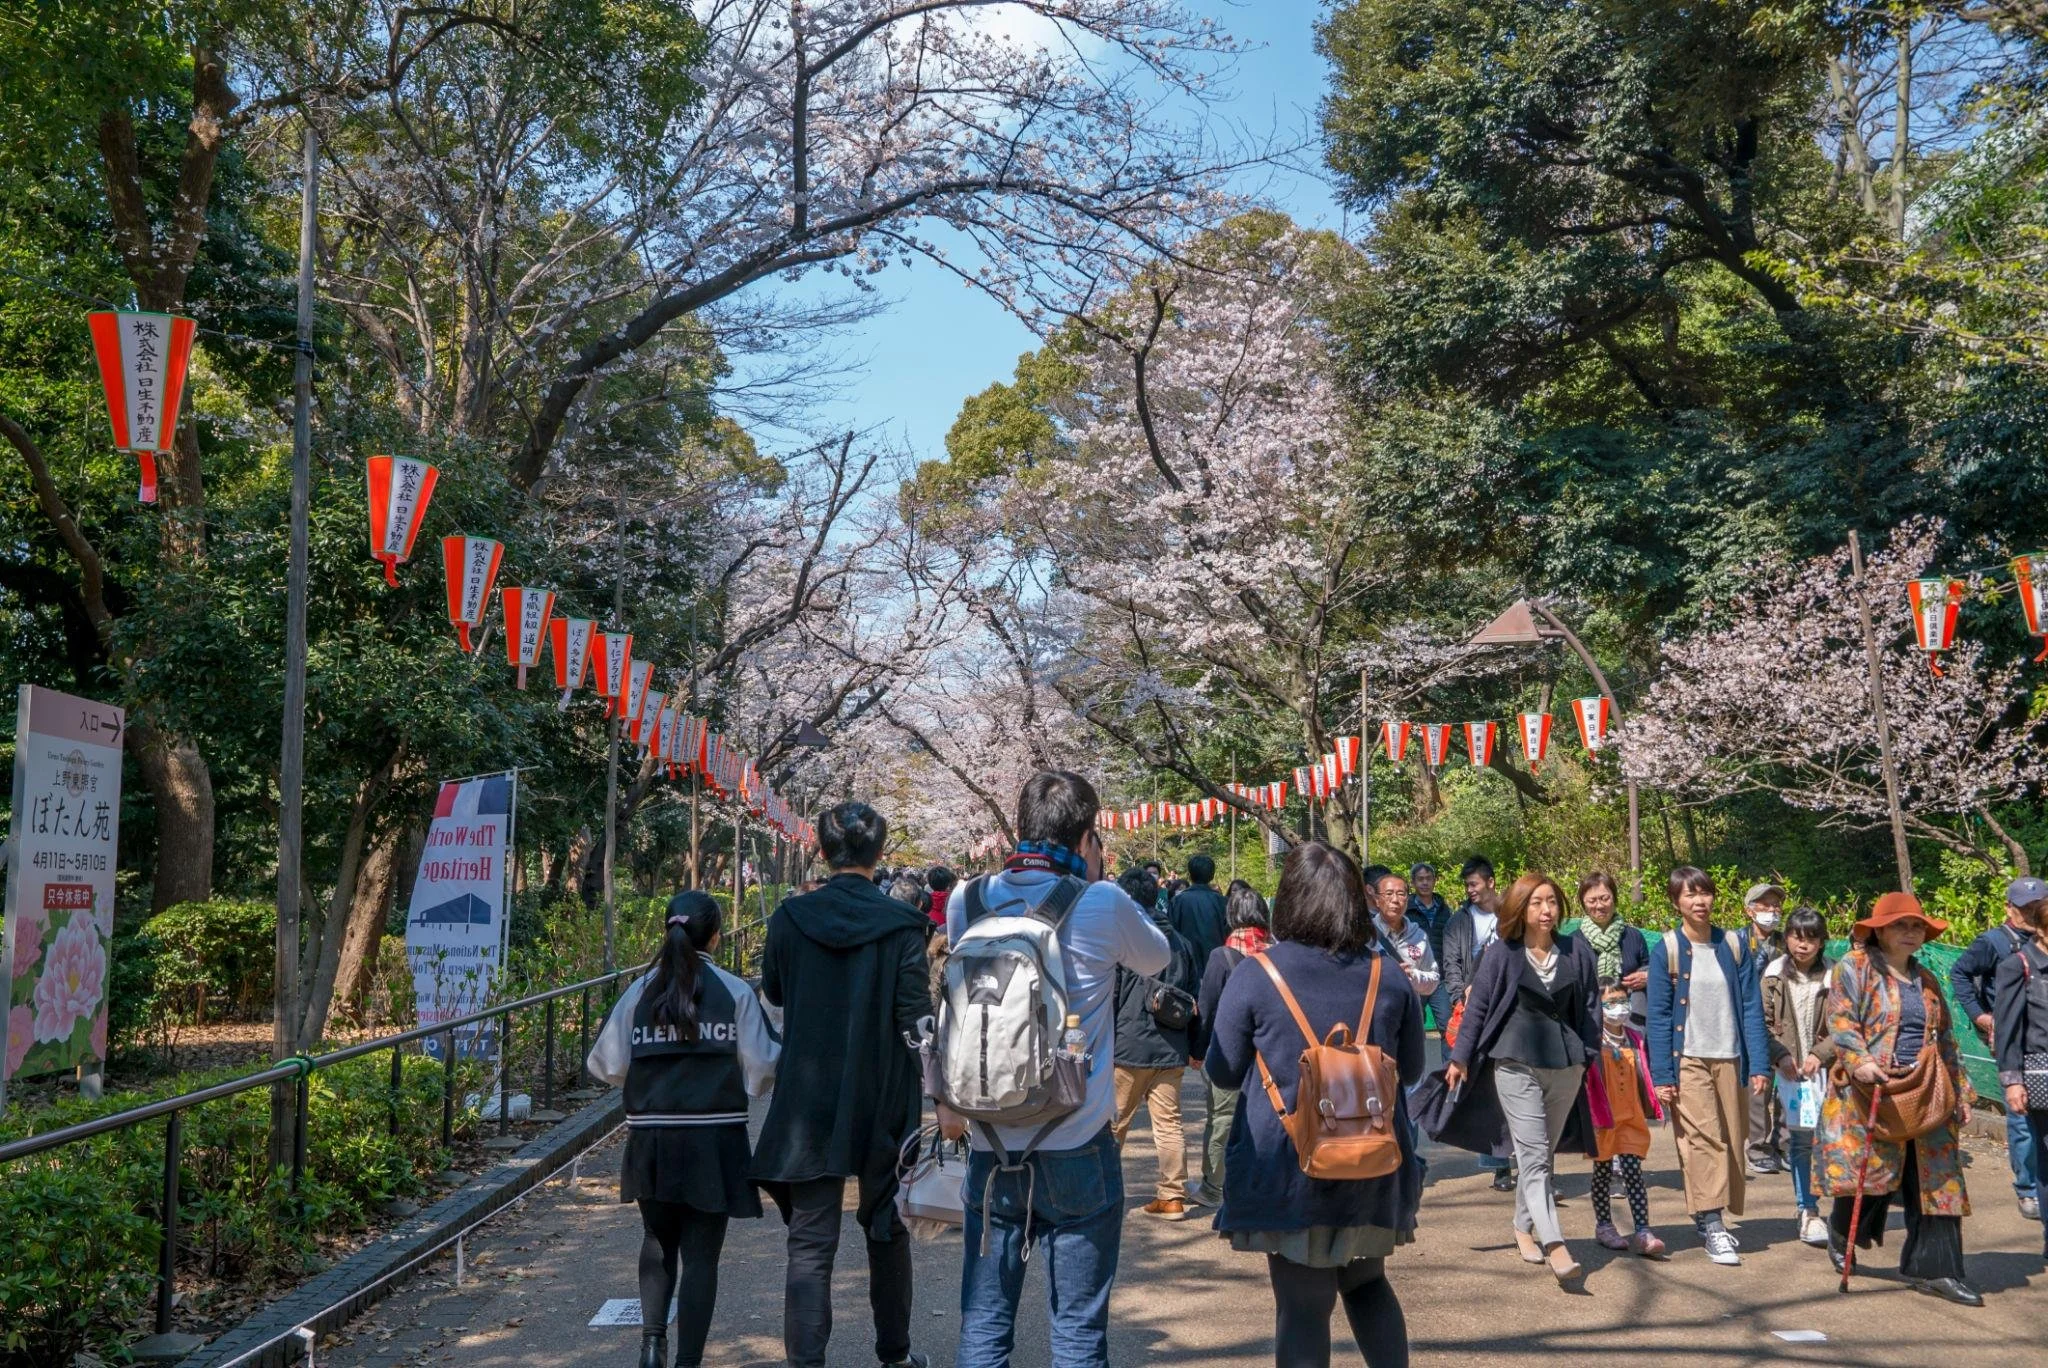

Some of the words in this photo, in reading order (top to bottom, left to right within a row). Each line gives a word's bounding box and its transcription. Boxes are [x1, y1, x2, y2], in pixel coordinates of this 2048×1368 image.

[80, 711, 99, 732] 入口
[52, 769, 98, 793] 上野東照宮
[32, 792, 110, 841] ぼたん苑
[1022, 857, 1050, 868] Canon
[47, 888, 90, 905] 只今休苑中
[631, 1022, 737, 1046] CLEMNCE
